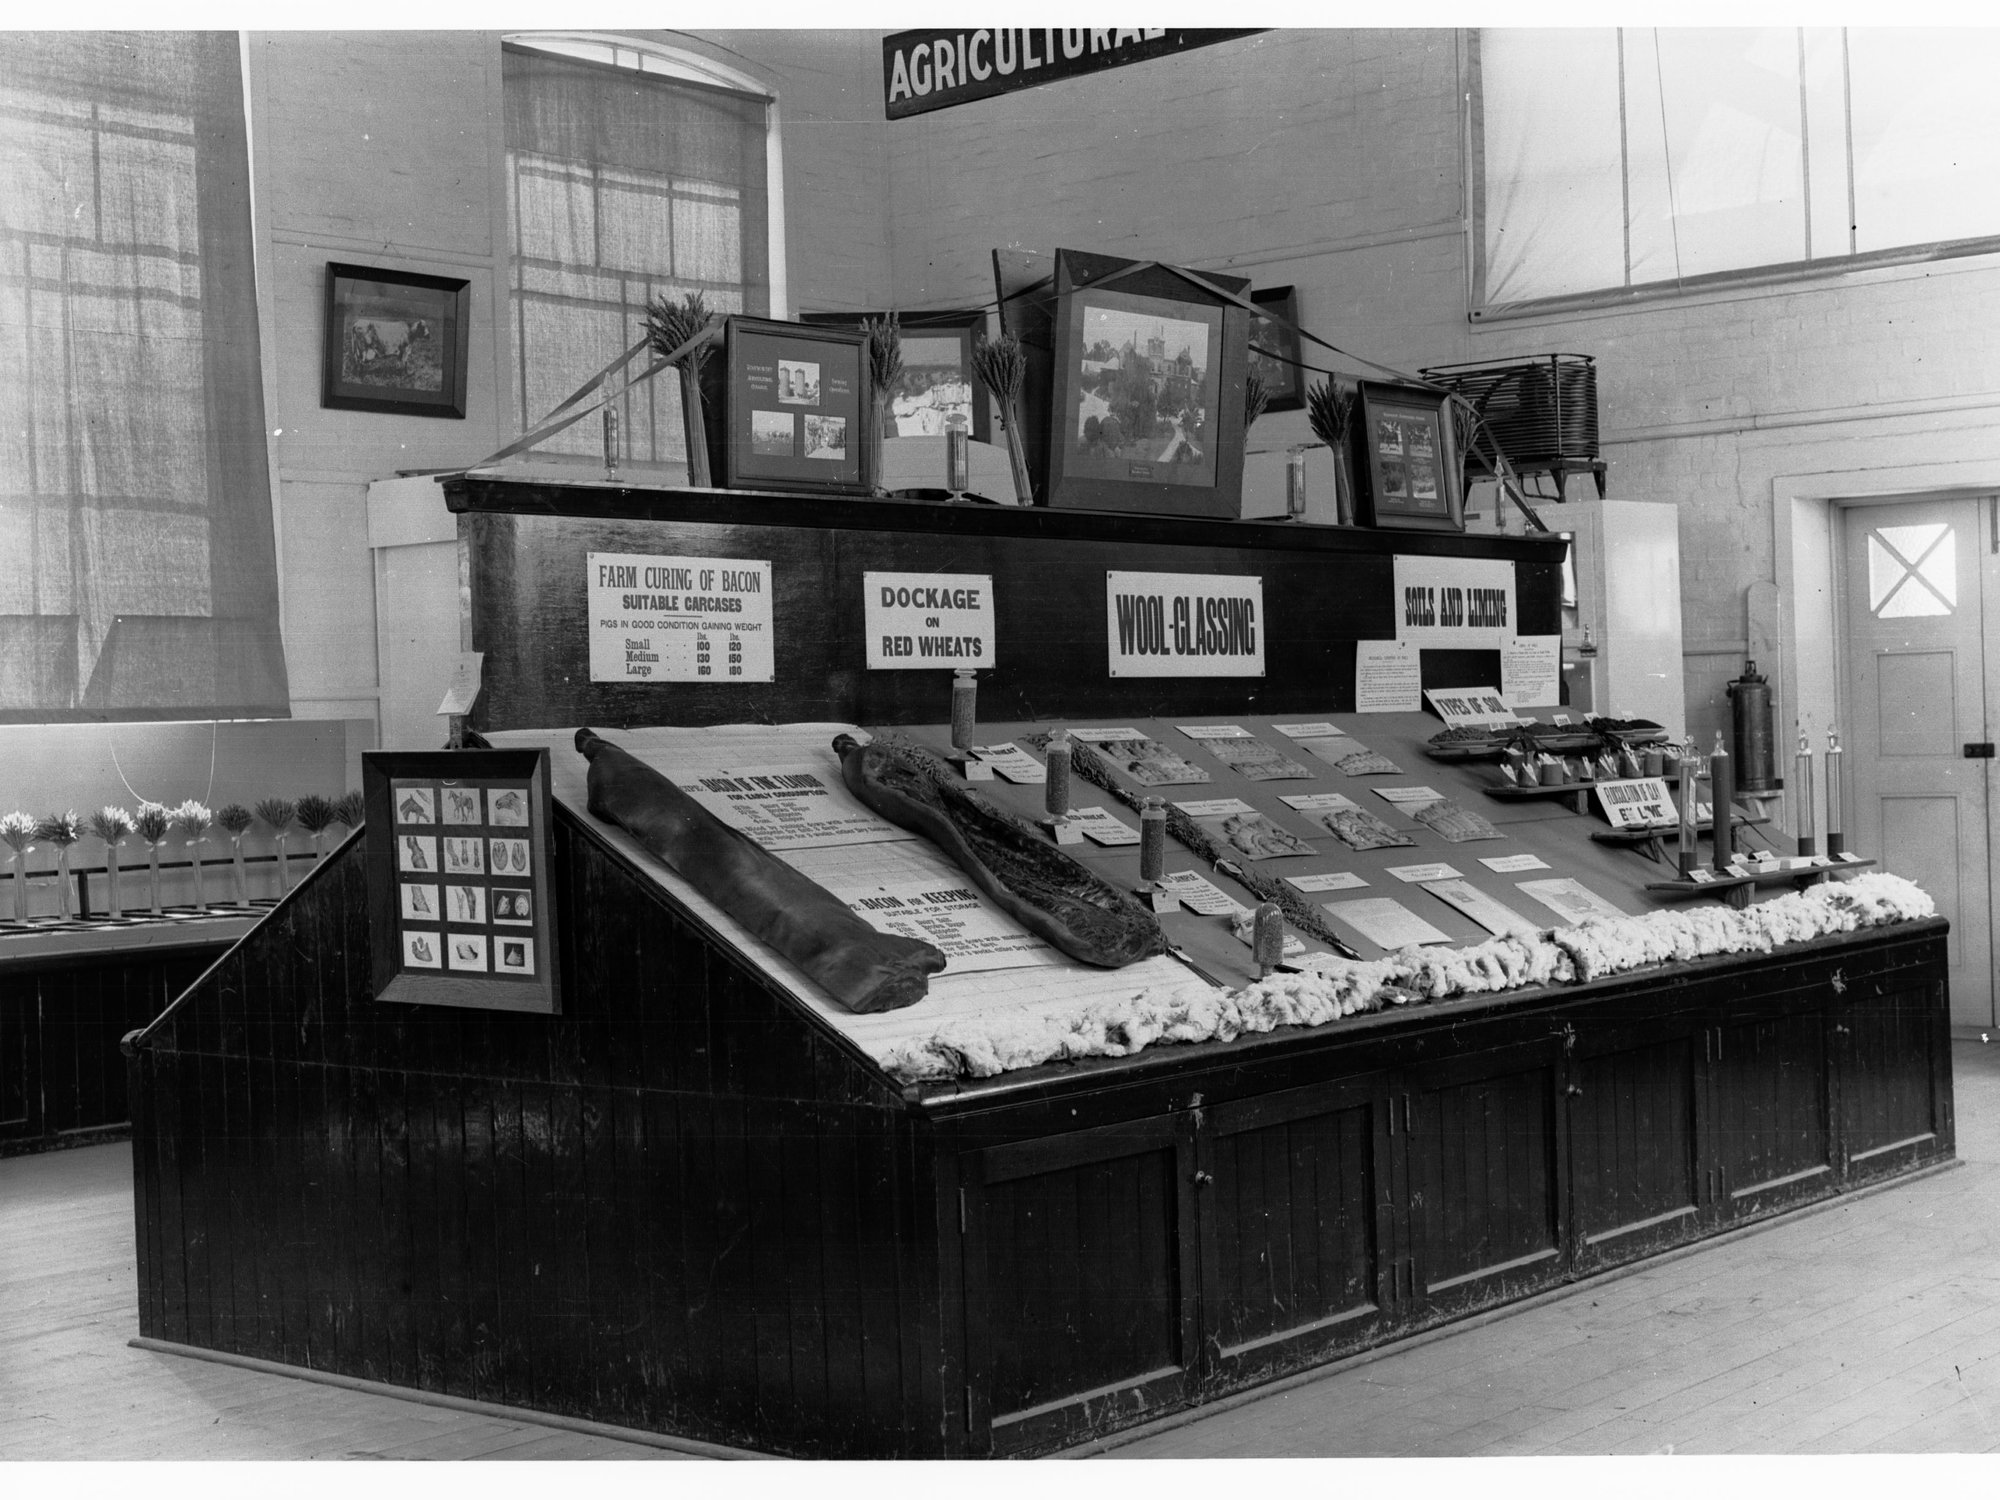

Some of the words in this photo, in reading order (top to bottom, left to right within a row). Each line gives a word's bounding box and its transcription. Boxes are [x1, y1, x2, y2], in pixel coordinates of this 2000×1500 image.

[599, 565, 637, 588] FARM
[645, 567, 692, 590] CURING
[700, 569, 714, 591] OF
[722, 570, 760, 592] BACON
[623, 594, 679, 611] SUITABLE
[685, 596, 742, 612] CARCASES
[881, 587, 980, 609] DOCKAGE
[1405, 587, 1435, 627] SOILS
[1440, 587, 1463, 627] AND
[1467, 588, 1507, 627] LIMING
[600, 620, 617, 628] PIGS
[621, 620, 628, 628] IN
[632, 620, 654, 629] GOOD
[657, 621, 699, 630] CONDITION
[702, 622, 732, 630] GAINING
[734, 623, 762, 631] WEIGHT
[925, 617, 940, 628] ON
[1116, 594, 1255, 655] WOOL-CLASSING
[625, 639, 650, 650] Small
[697, 641, 710, 651] 100
[729, 642, 742, 651] 120
[882, 636, 913, 656] RED
[918, 636, 982, 657] WHEATS
[625, 650, 659, 662] Medium
[697, 653, 710, 663] 130
[729, 653, 742, 663] 150
[626, 663, 652, 677] Large
[698, 665, 711, 675] 160
[1435, 698, 1471, 715] TYPES
[1467, 697, 1484, 714] OF
[1482, 696, 1508, 713] SOIL
[699, 778, 743, 793] BACON
[733, 777, 755, 791] OF
[748, 776, 782, 790] FINE
[772, 774, 825, 789] FLAVOUR
[1637, 783, 1648, 801] OF
[859, 896, 905, 910] BACON
[921, 888, 979, 904] KEEPING
[883, 908, 923, 917] SUITABLE
[924, 905, 943, 913] FOR
[944, 902, 981, 910] STORAGE
